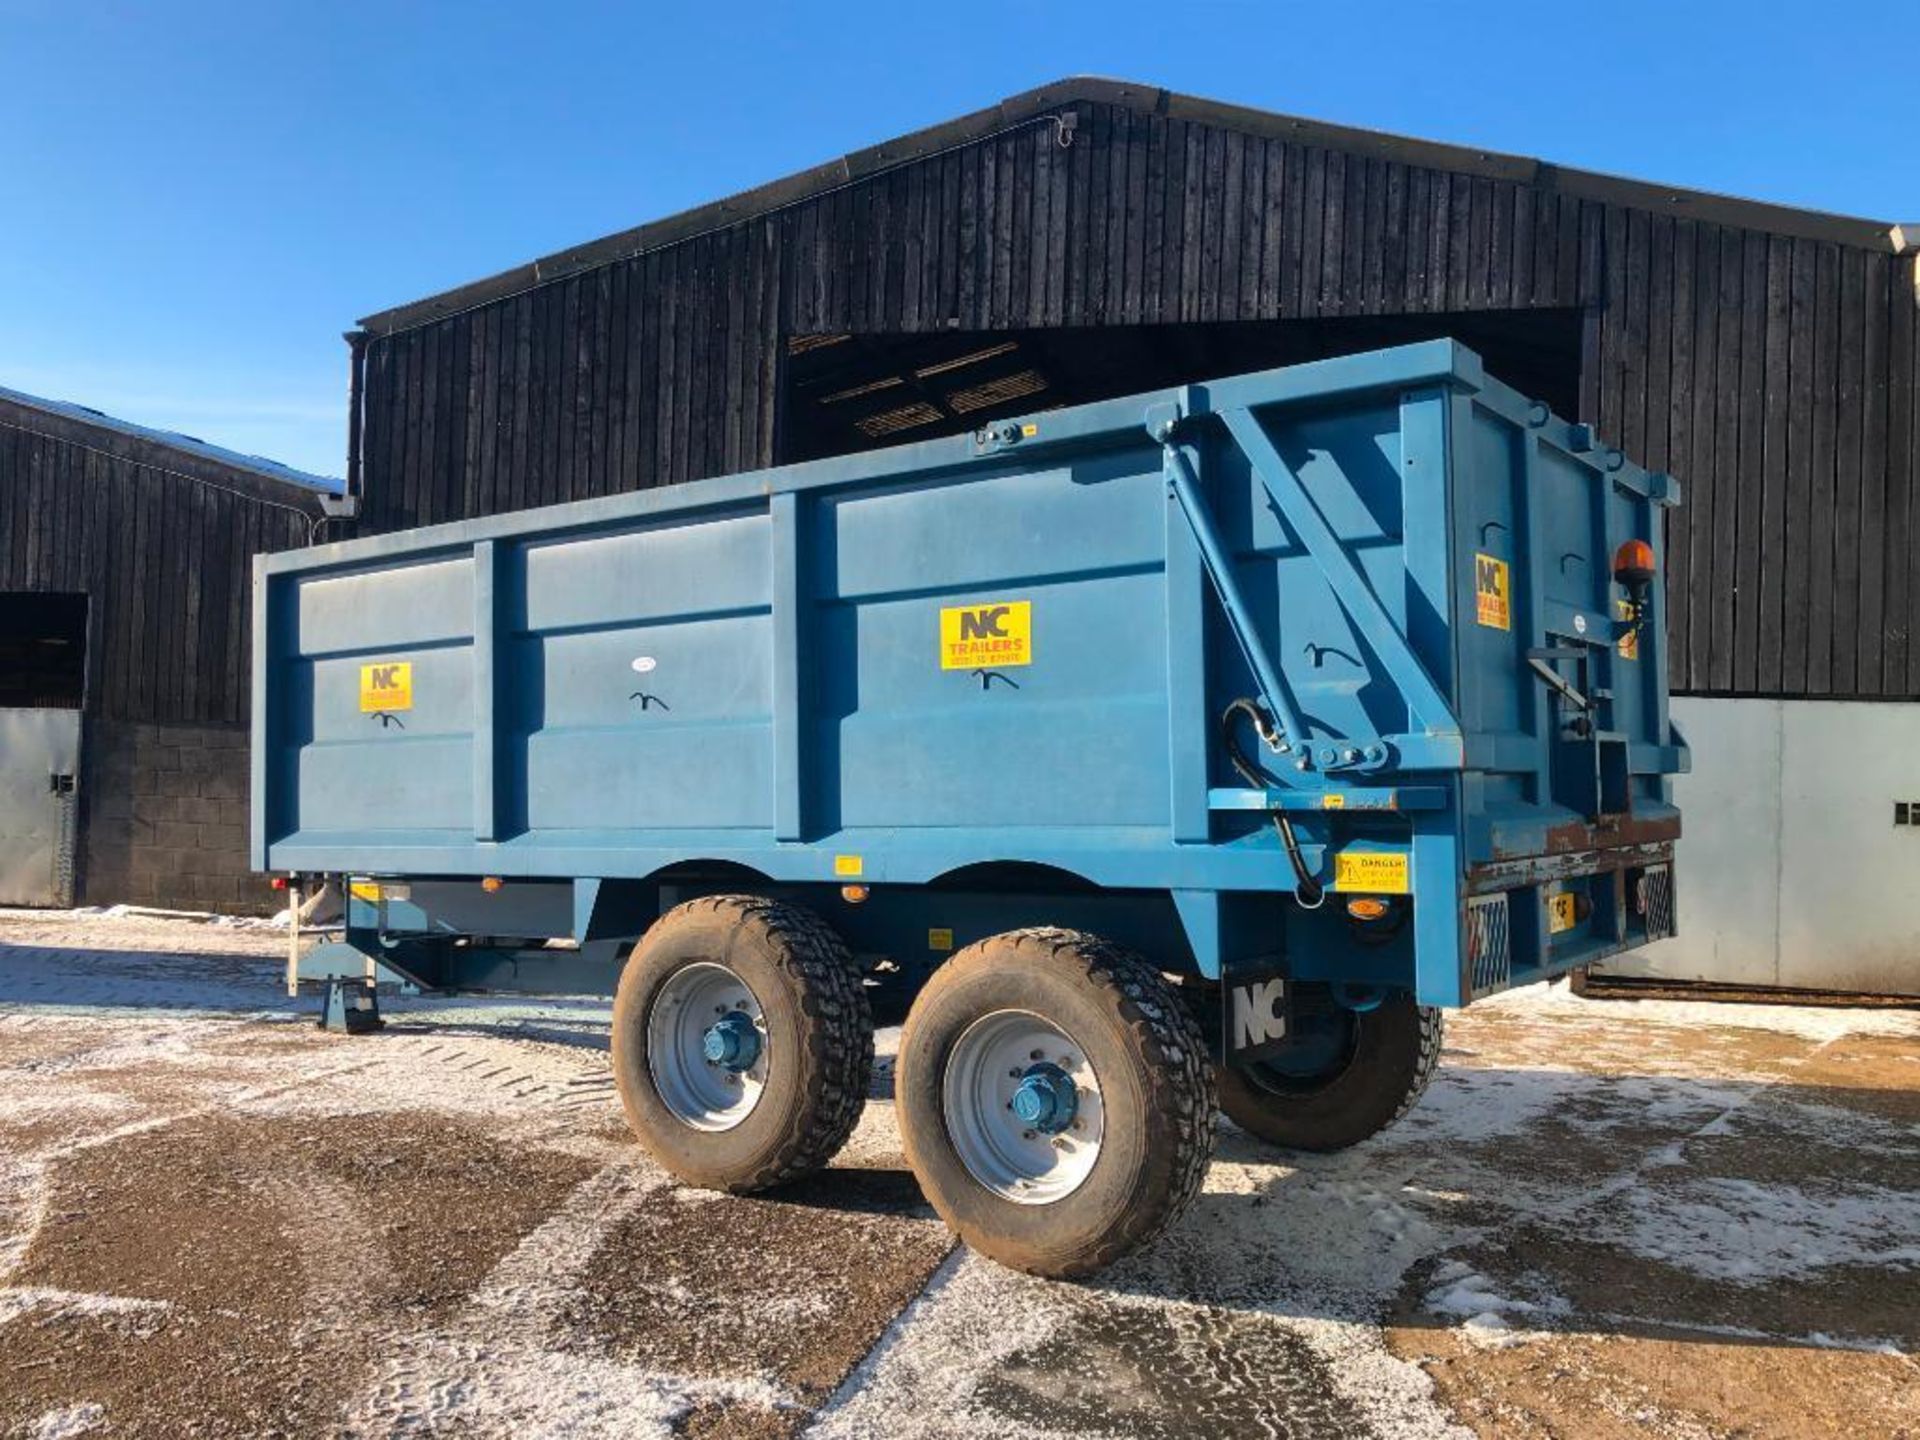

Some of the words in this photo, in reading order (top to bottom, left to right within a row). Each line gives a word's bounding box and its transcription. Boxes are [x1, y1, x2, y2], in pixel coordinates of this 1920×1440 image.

[1478, 560, 1501, 597] NC
[961, 606, 1010, 640] NC
[949, 639, 1023, 656] TRAILERS
[372, 666, 399, 690] NC
[1232, 978, 1285, 1049] NC
